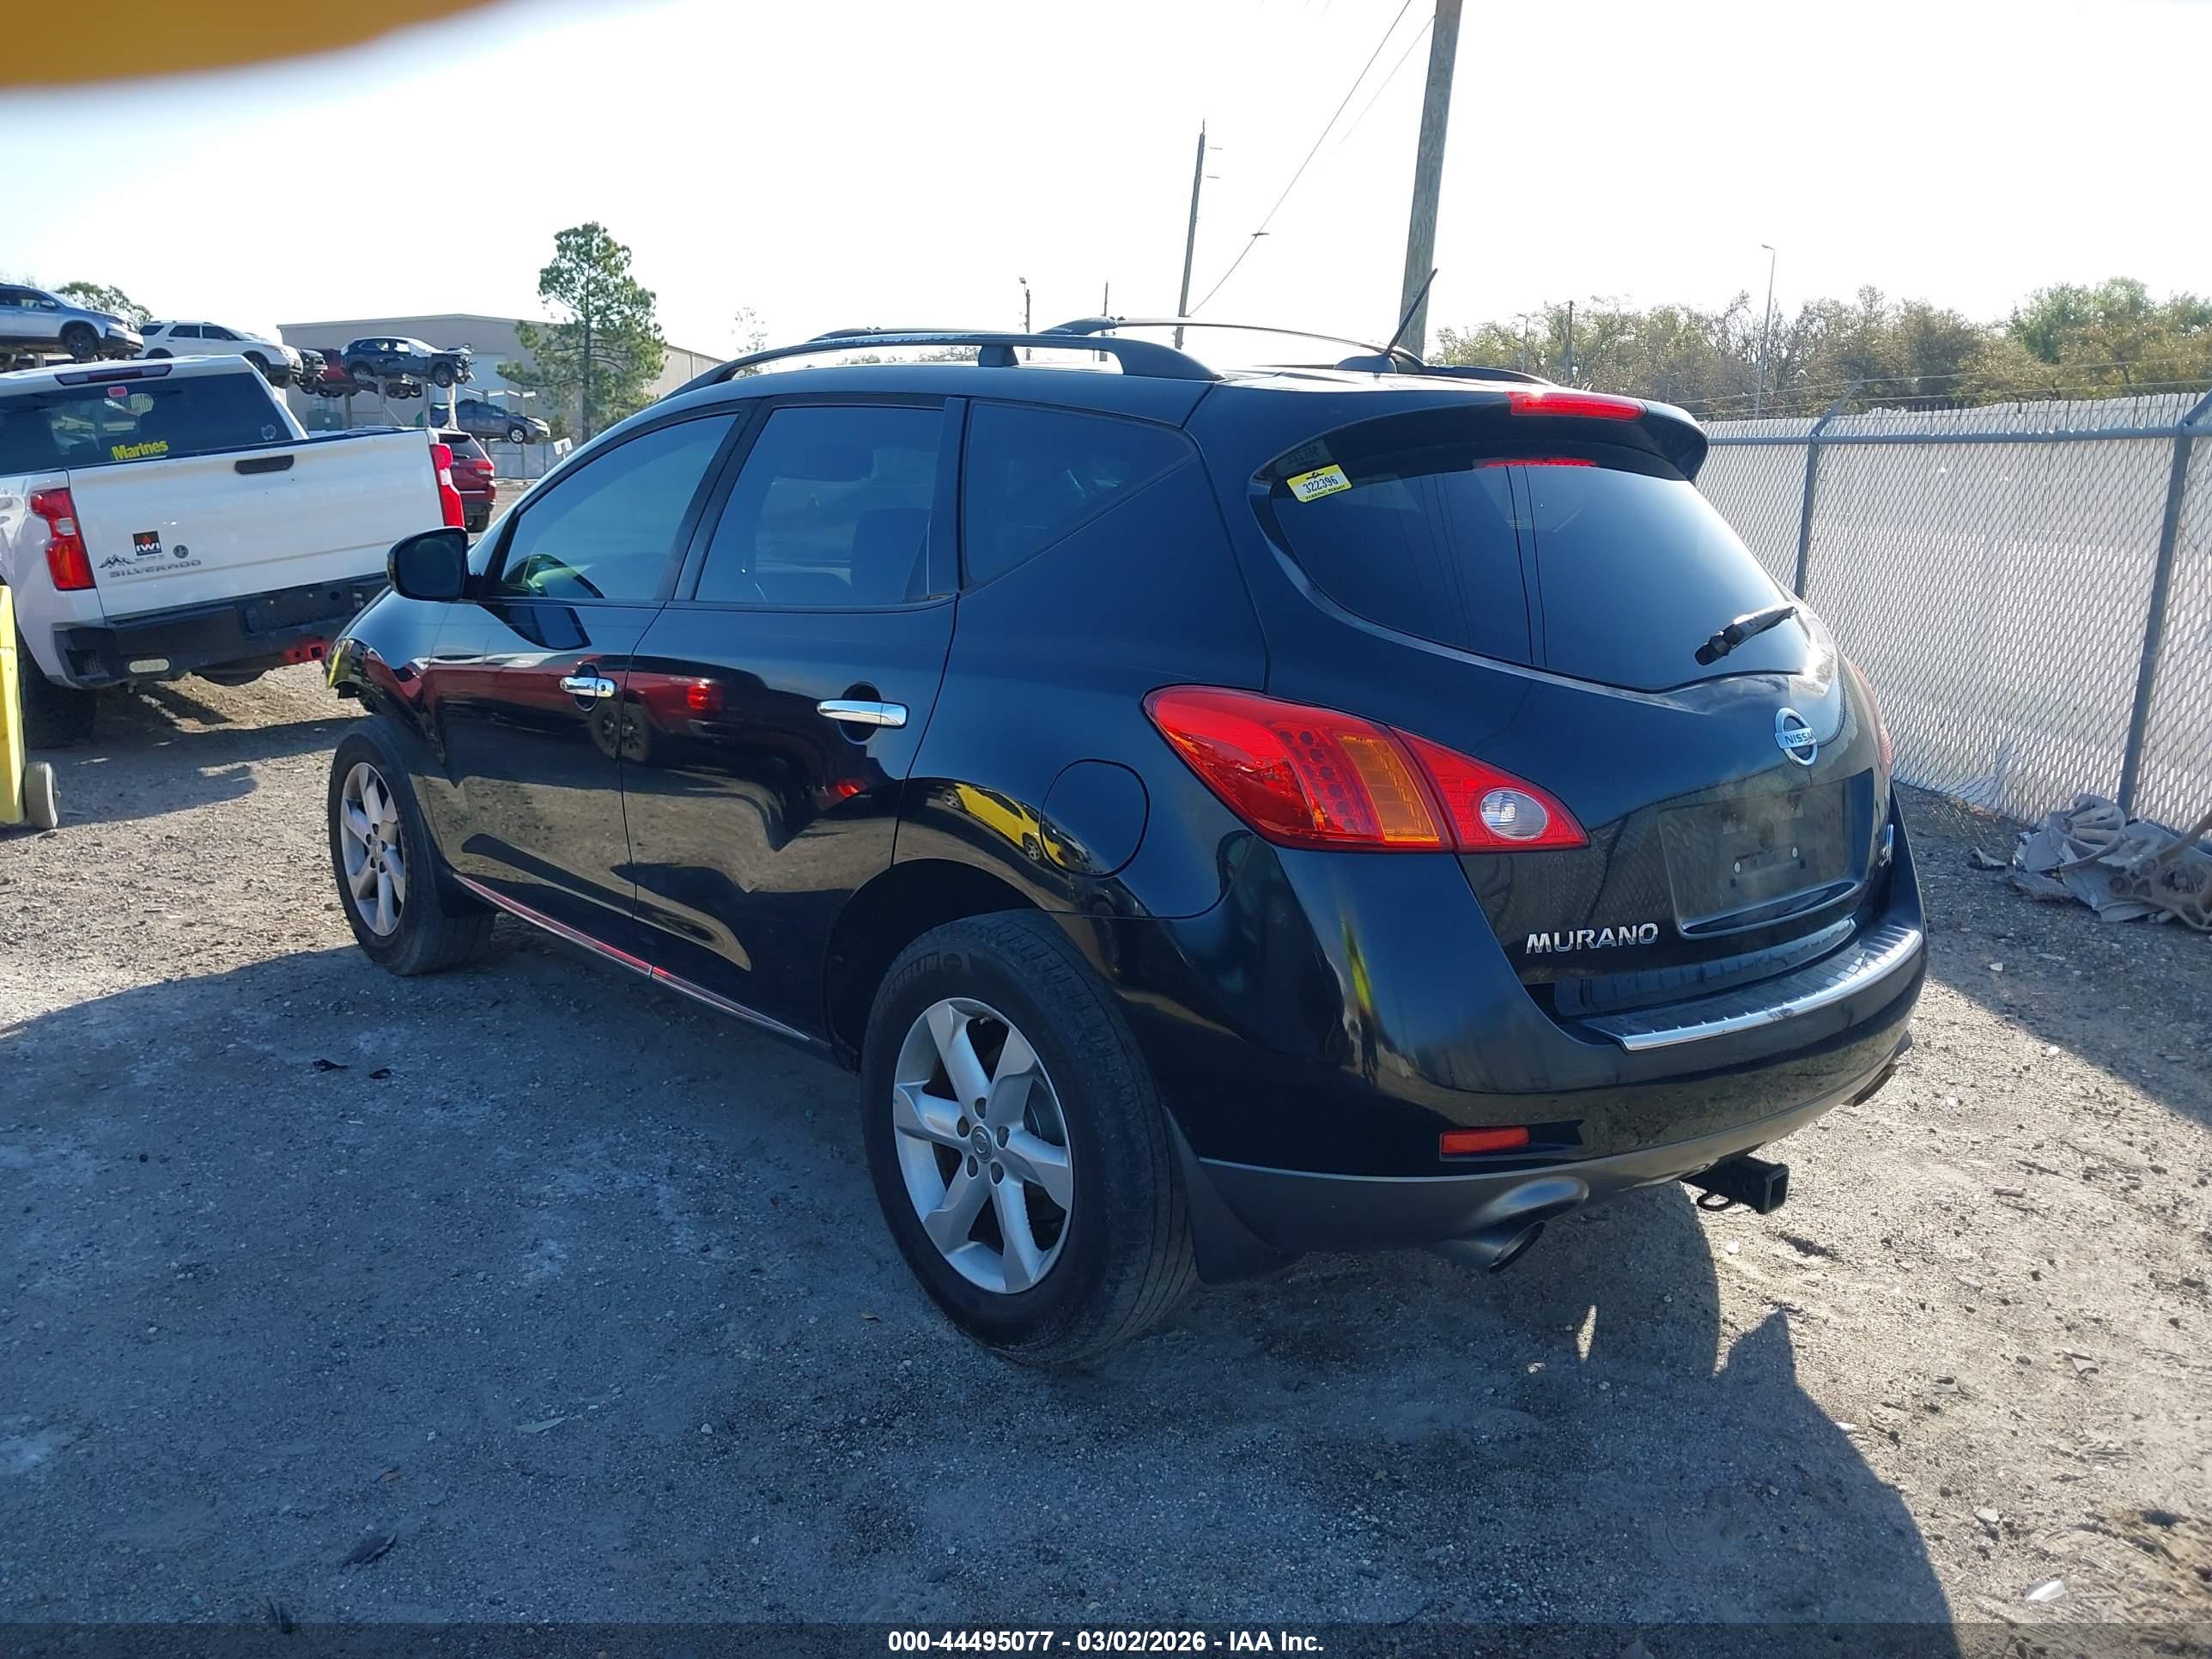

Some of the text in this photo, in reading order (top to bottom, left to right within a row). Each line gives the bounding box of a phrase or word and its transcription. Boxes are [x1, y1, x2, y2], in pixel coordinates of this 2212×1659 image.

[112, 441, 168, 461] Marines
[1303, 475, 1339, 494] 322396
[1305, 489, 1328, 500] PARKING
[136, 542, 161, 552] IWI
[109, 559, 202, 579] SILVERADO
[1525, 922, 1659, 954] MURANO
